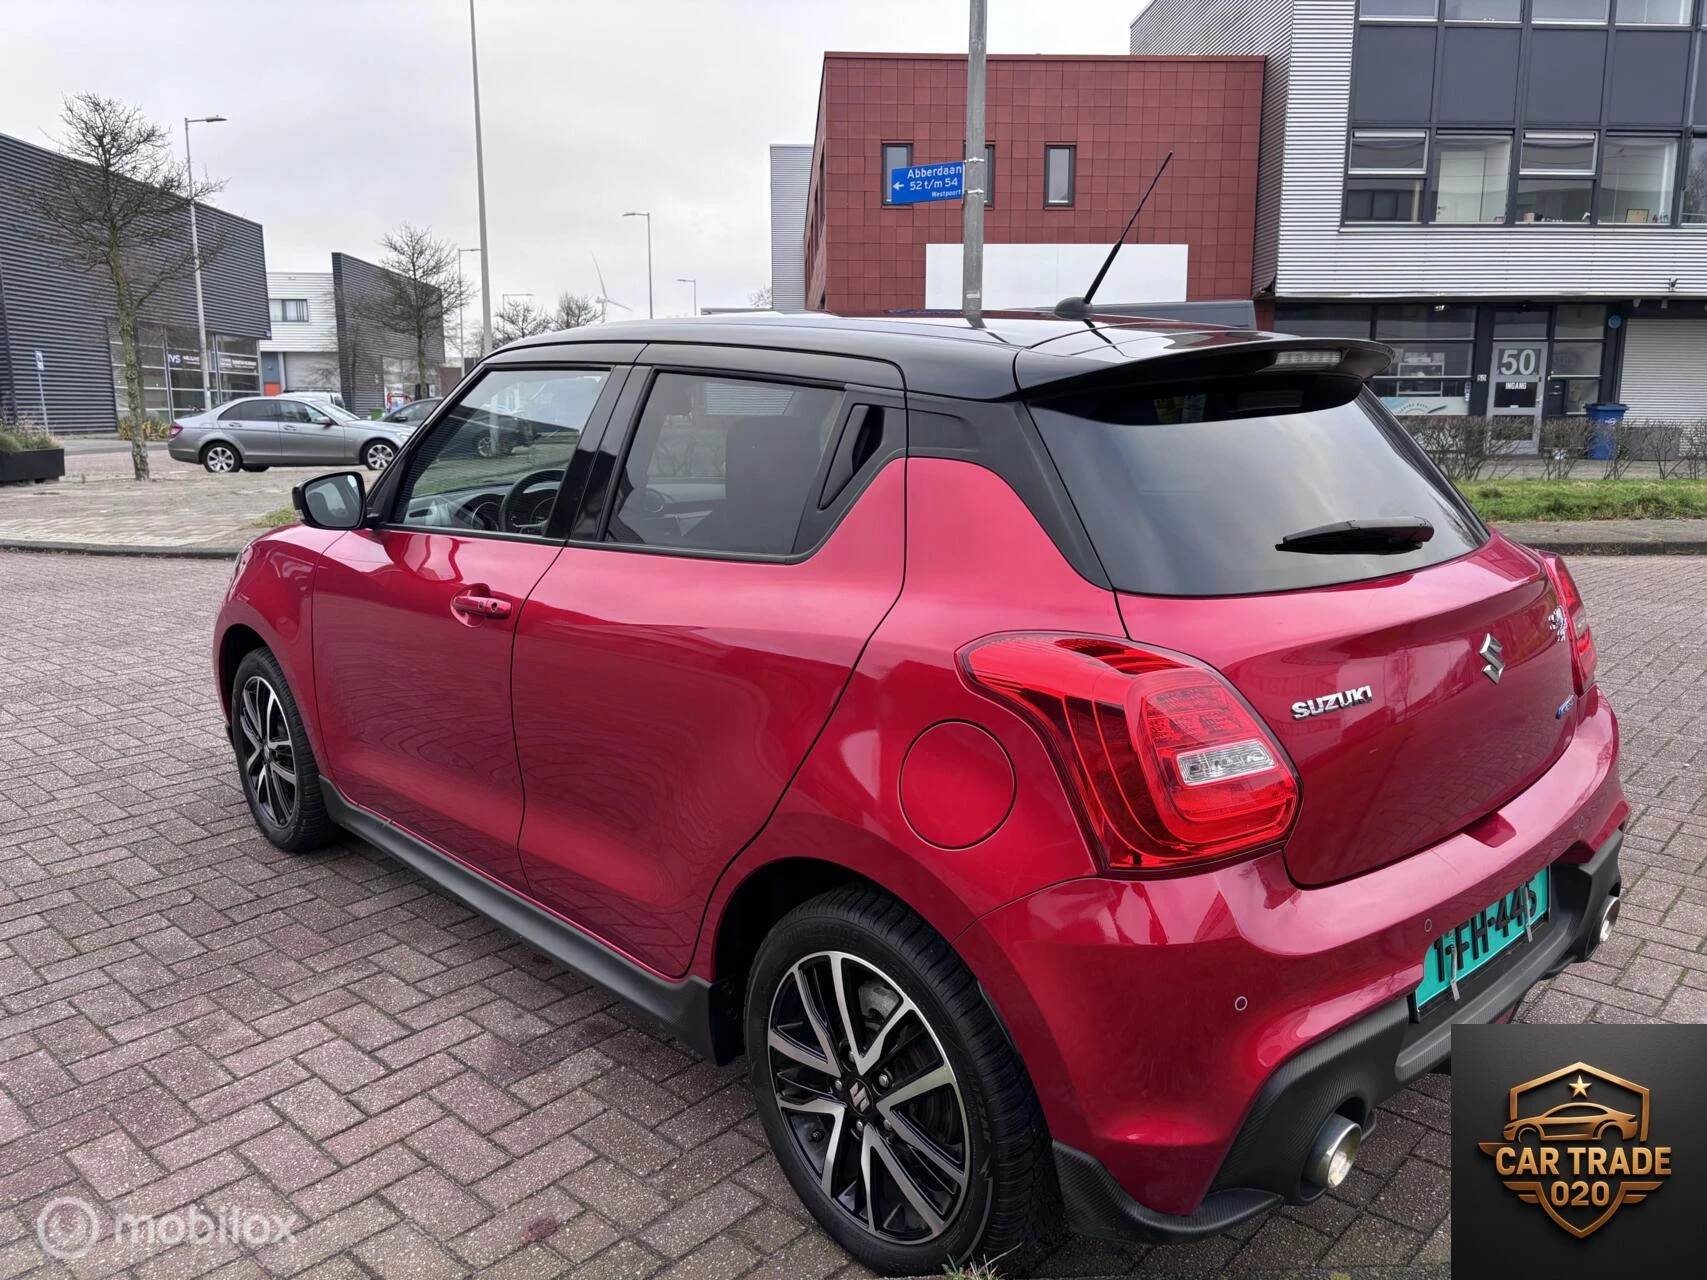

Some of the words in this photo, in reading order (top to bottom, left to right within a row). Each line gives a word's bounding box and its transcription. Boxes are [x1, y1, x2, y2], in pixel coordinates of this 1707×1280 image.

[907, 166, 962, 179] Abberdaan
[909, 181, 923, 191] 52
[924, 179, 943, 190] t/m
[944, 177, 958, 187] 54
[931, 189, 962, 198] Westpoort
[1500, 349, 1536, 375] 50
[1505, 382, 1527, 390] INGANG
[1291, 685, 1373, 720] SUZUKI
